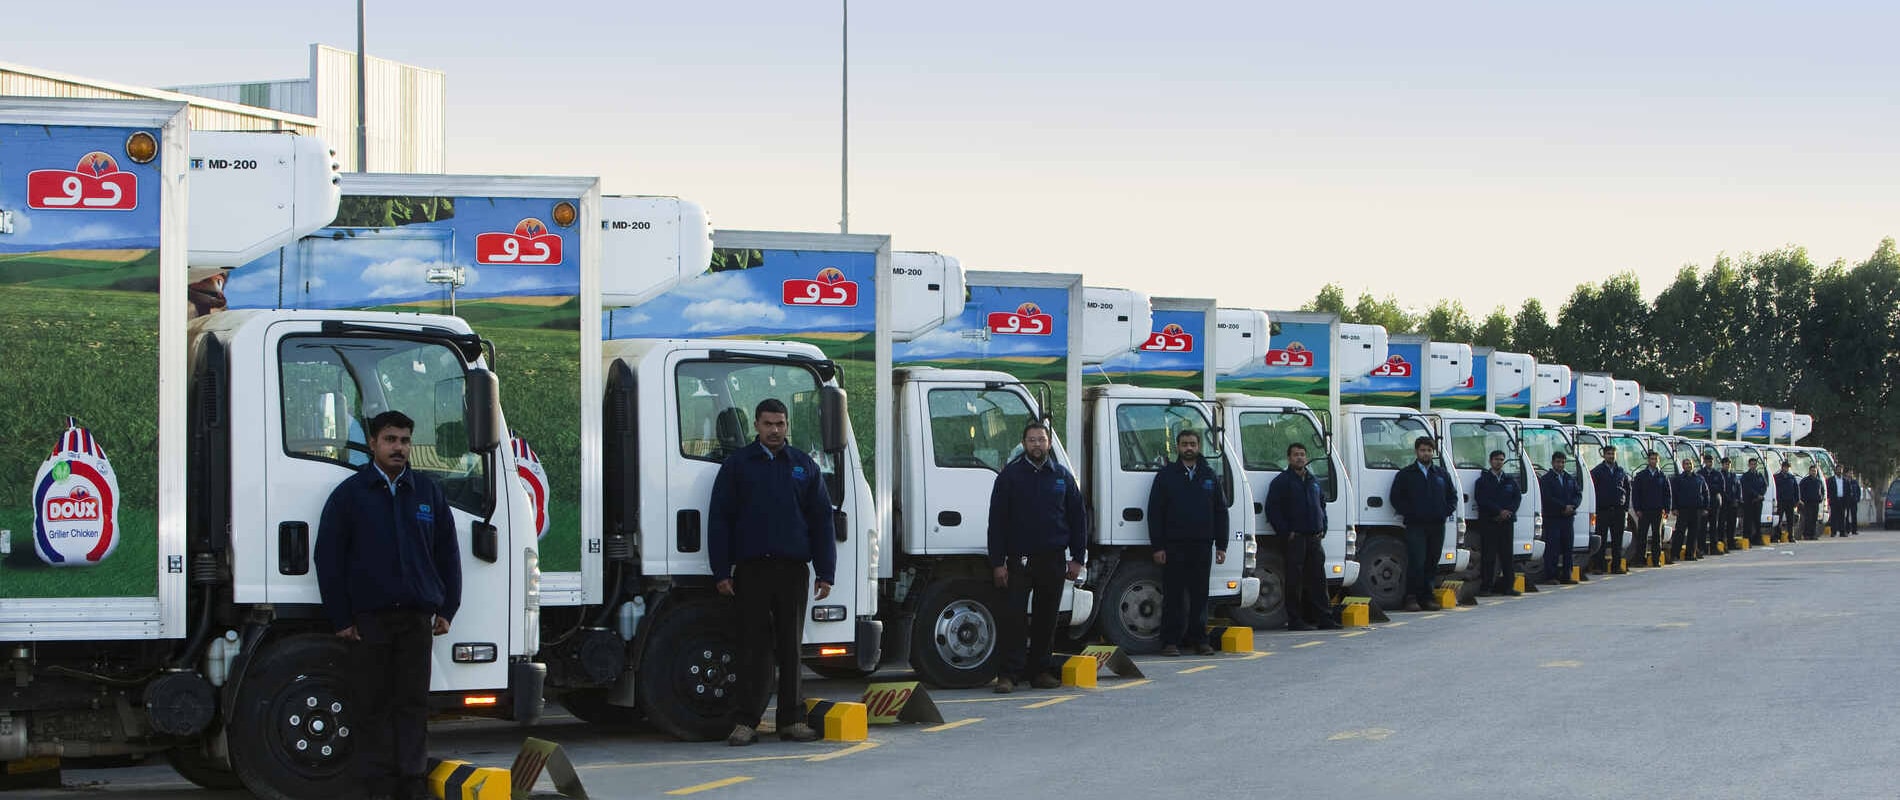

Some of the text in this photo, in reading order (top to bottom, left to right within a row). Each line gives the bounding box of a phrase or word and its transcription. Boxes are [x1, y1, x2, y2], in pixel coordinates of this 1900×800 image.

[208, 159, 257, 170] MD-200
[612, 221, 651, 230] MD-200
[892, 267, 922, 276] MD-200
[1087, 301, 1114, 310] MD-200
[49, 501, 97, 519] DOUX
